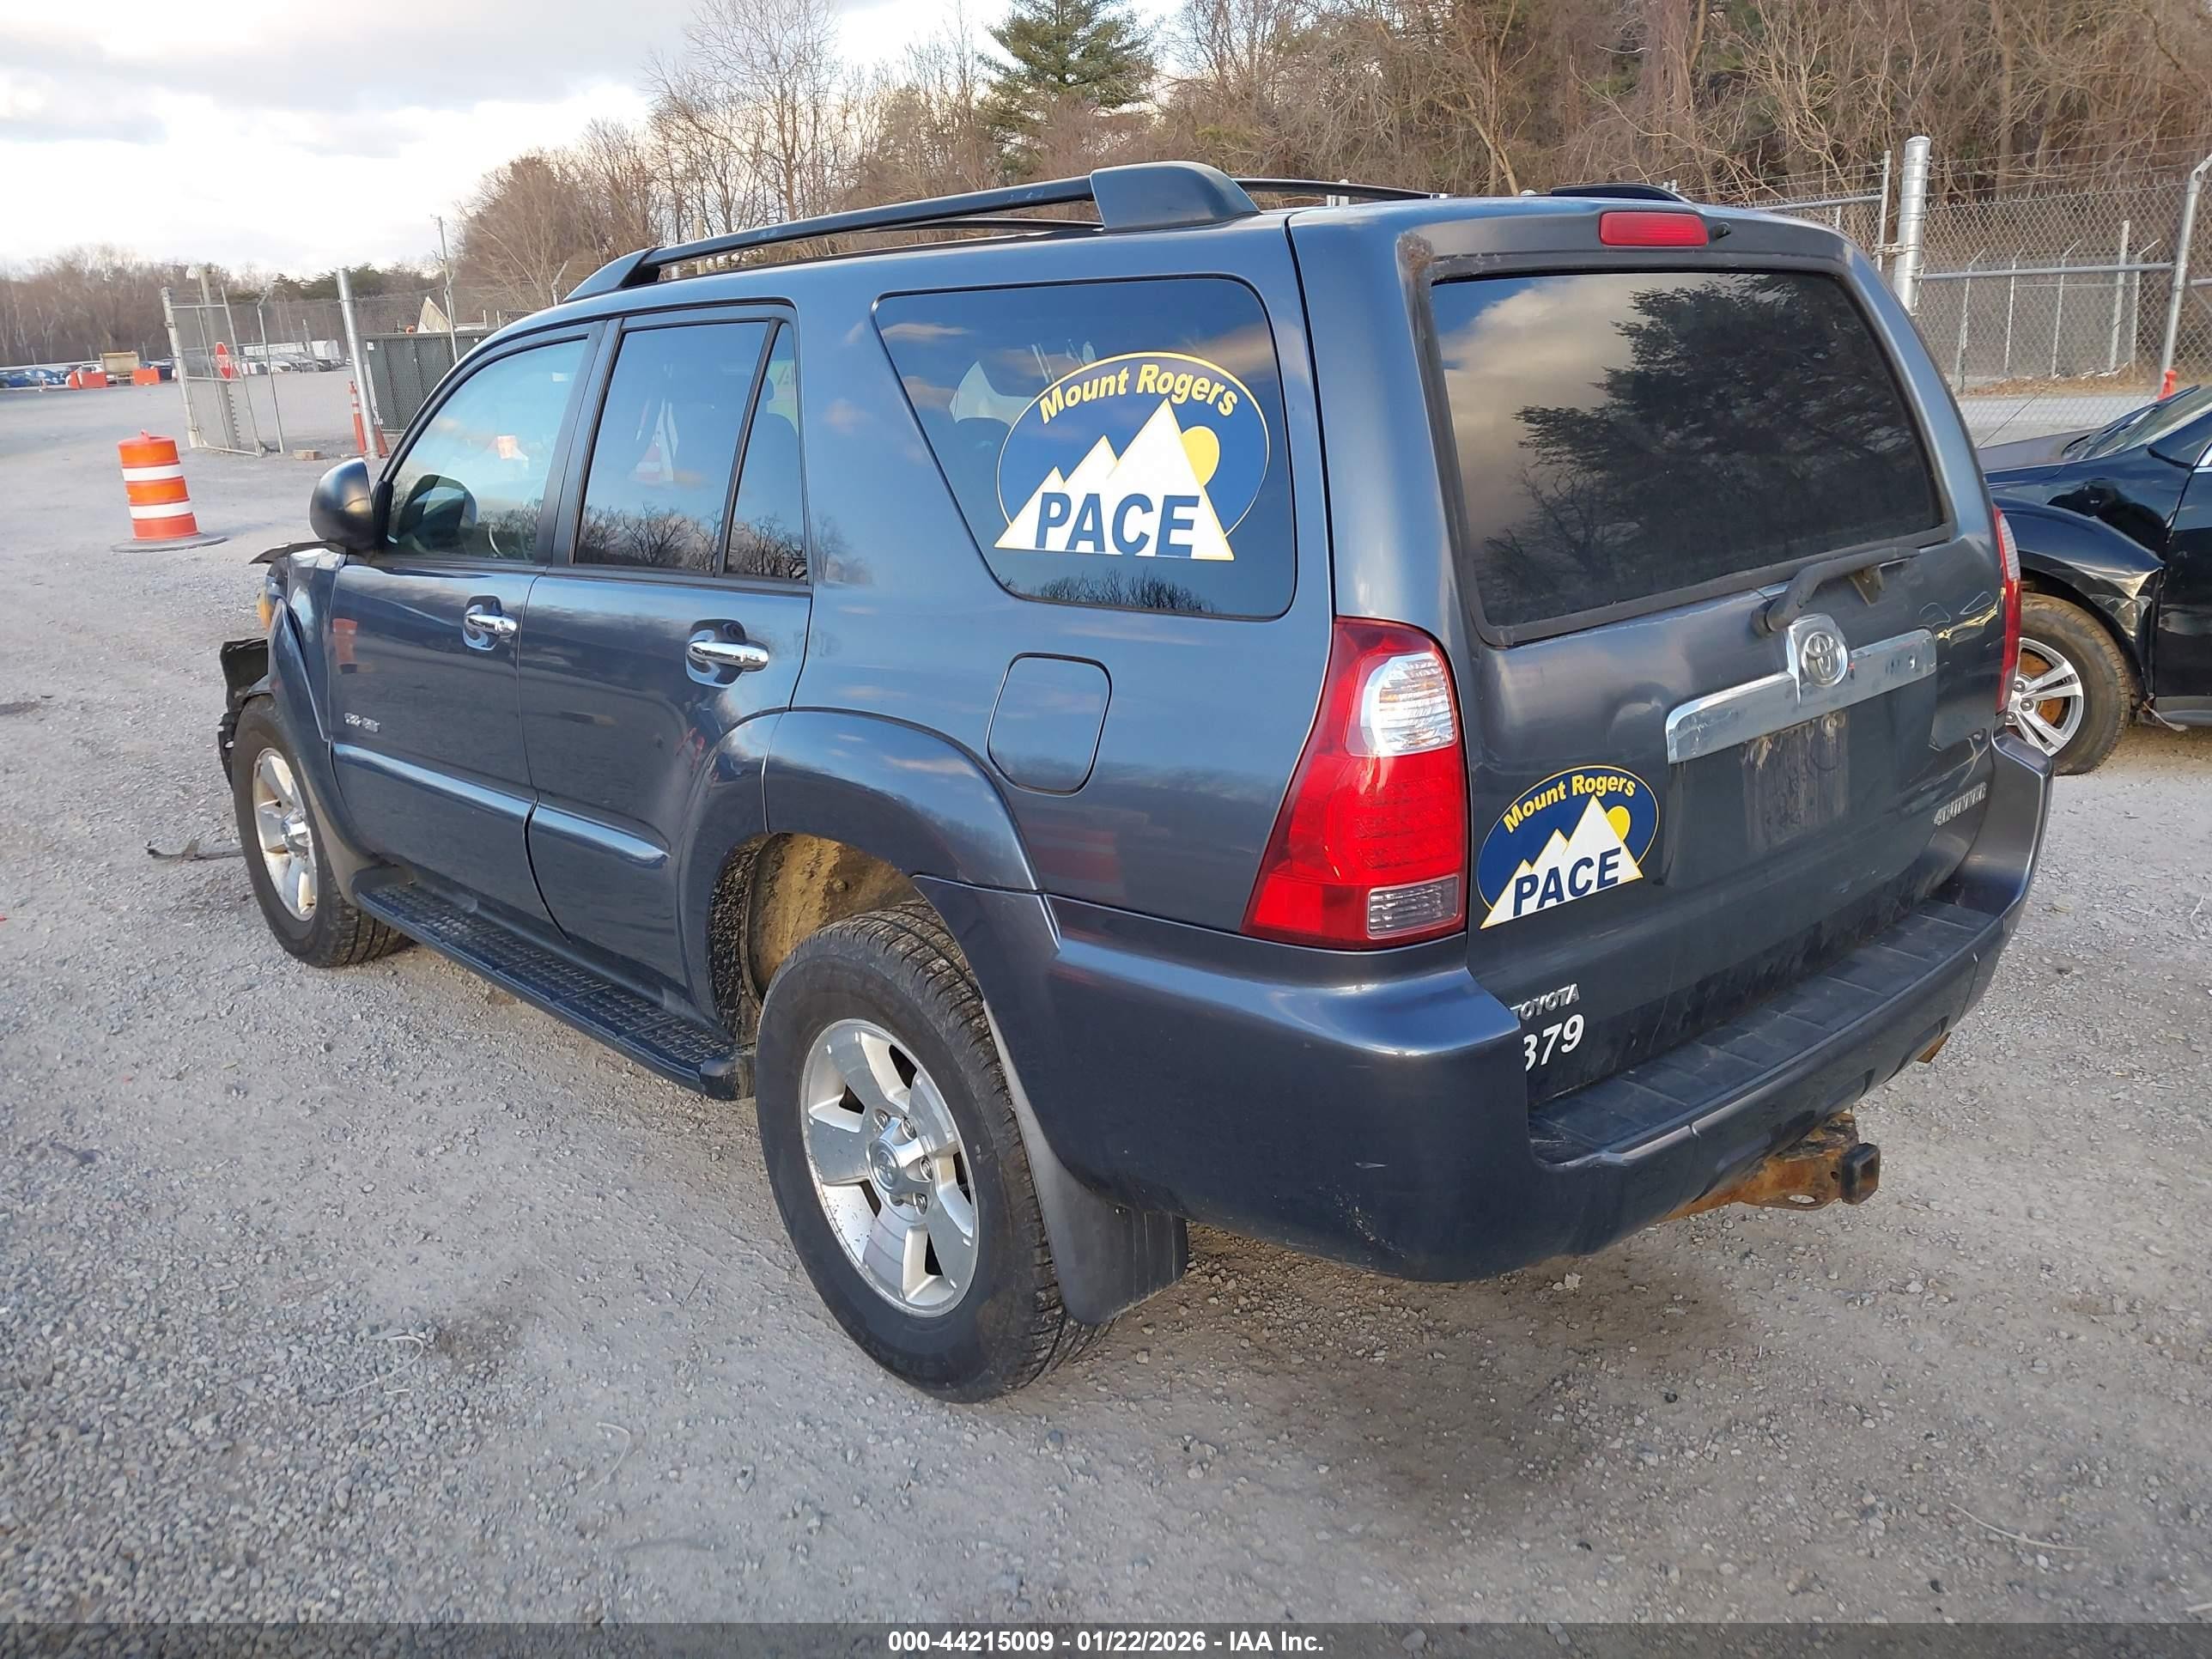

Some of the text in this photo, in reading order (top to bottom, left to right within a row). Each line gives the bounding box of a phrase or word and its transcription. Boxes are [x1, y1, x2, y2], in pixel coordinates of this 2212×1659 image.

[1038, 363, 1238, 424] Mount Rogers
[1035, 492, 1200, 558] PACE
[1504, 775, 1637, 833] Mount Rogers
[1513, 847, 1622, 917] PACE
